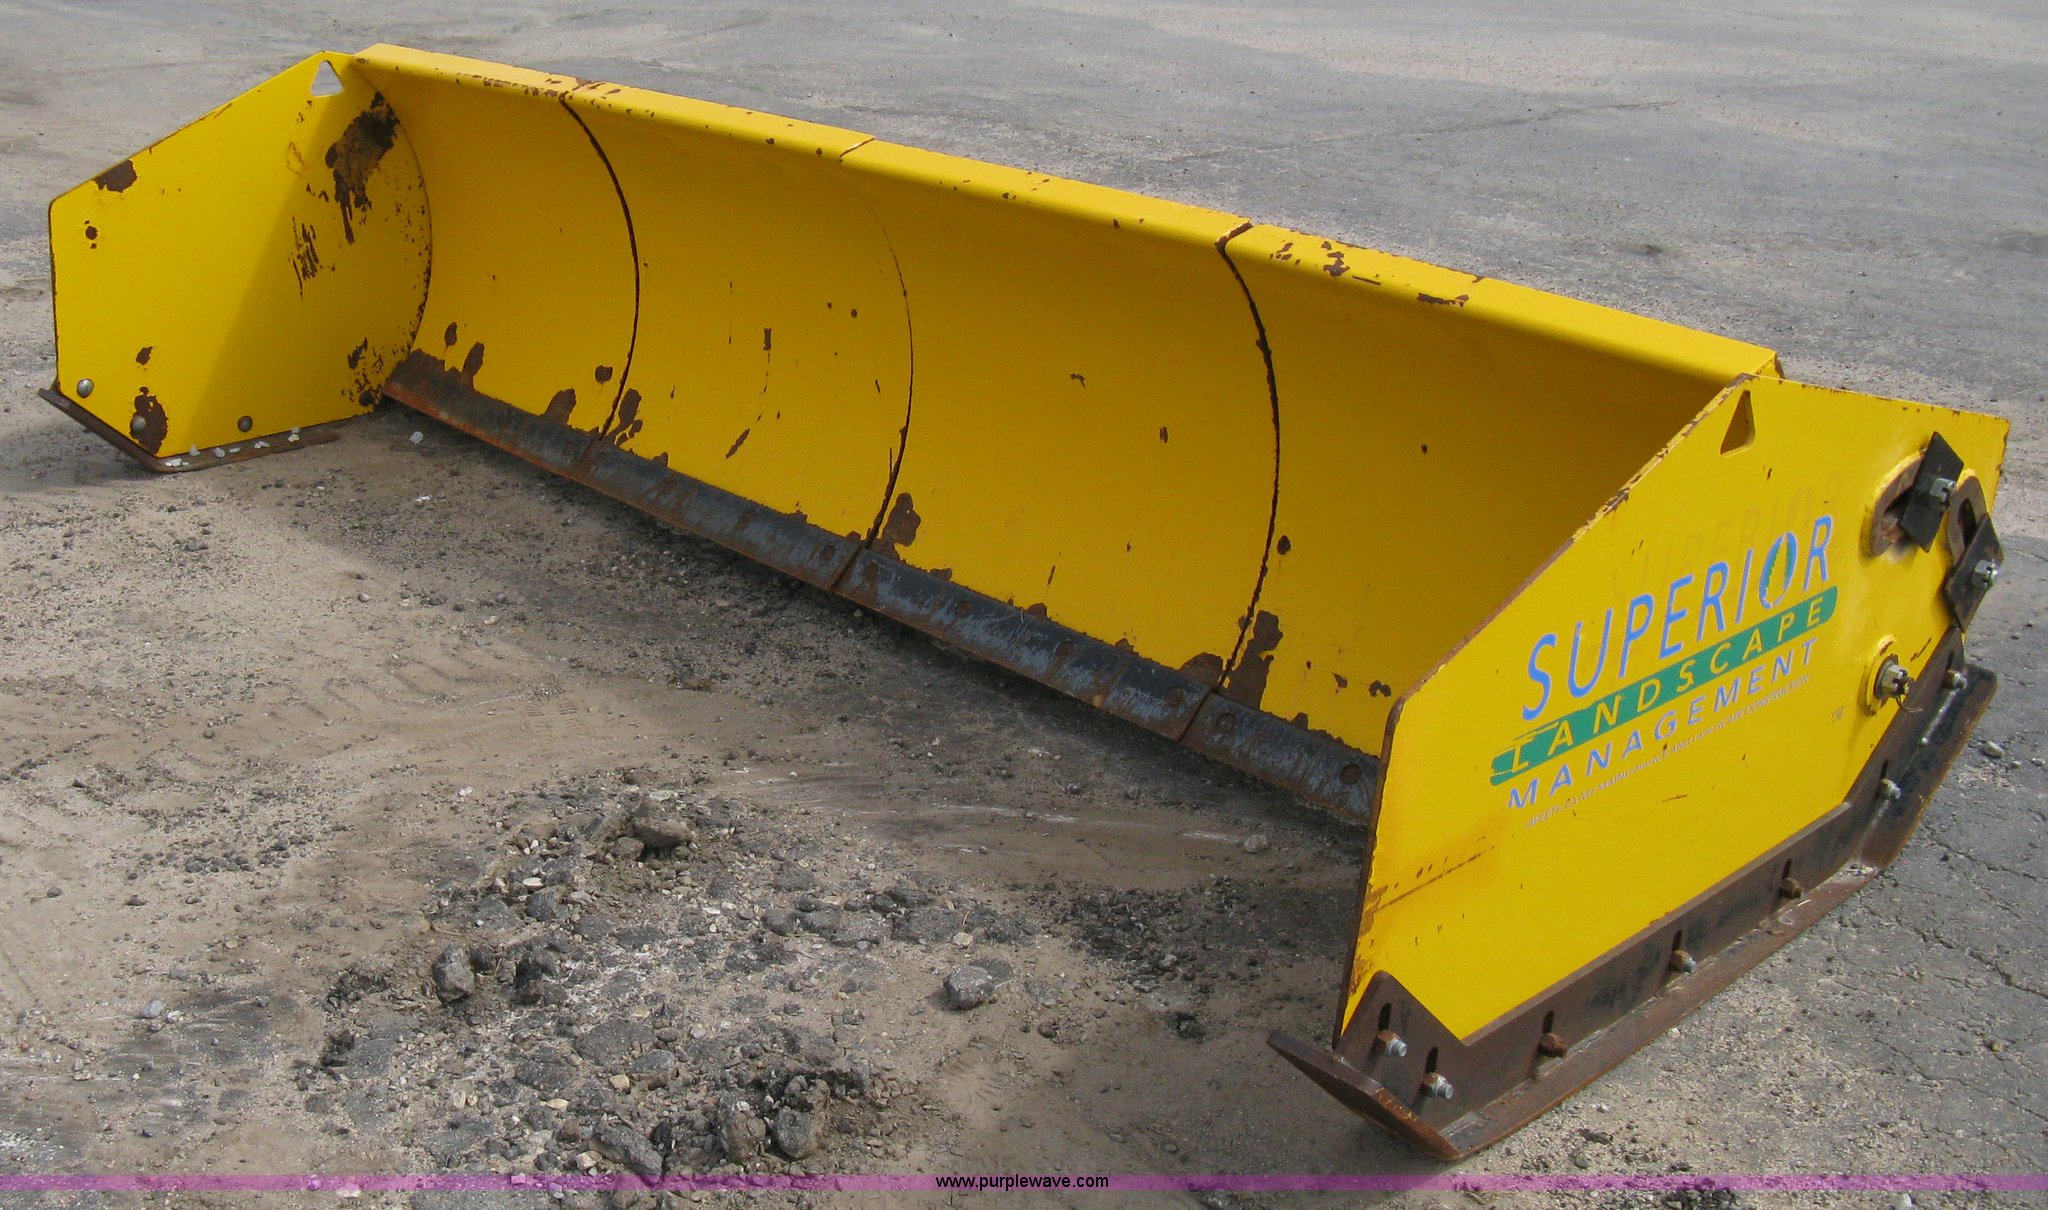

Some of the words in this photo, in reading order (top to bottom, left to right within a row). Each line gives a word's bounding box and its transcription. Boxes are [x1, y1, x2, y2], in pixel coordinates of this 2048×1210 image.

[1511, 596, 1824, 773] LANDSCAPE
[1520, 514, 1834, 722] SUPERIOR
[1507, 637, 1818, 809] MANAGEMENT
